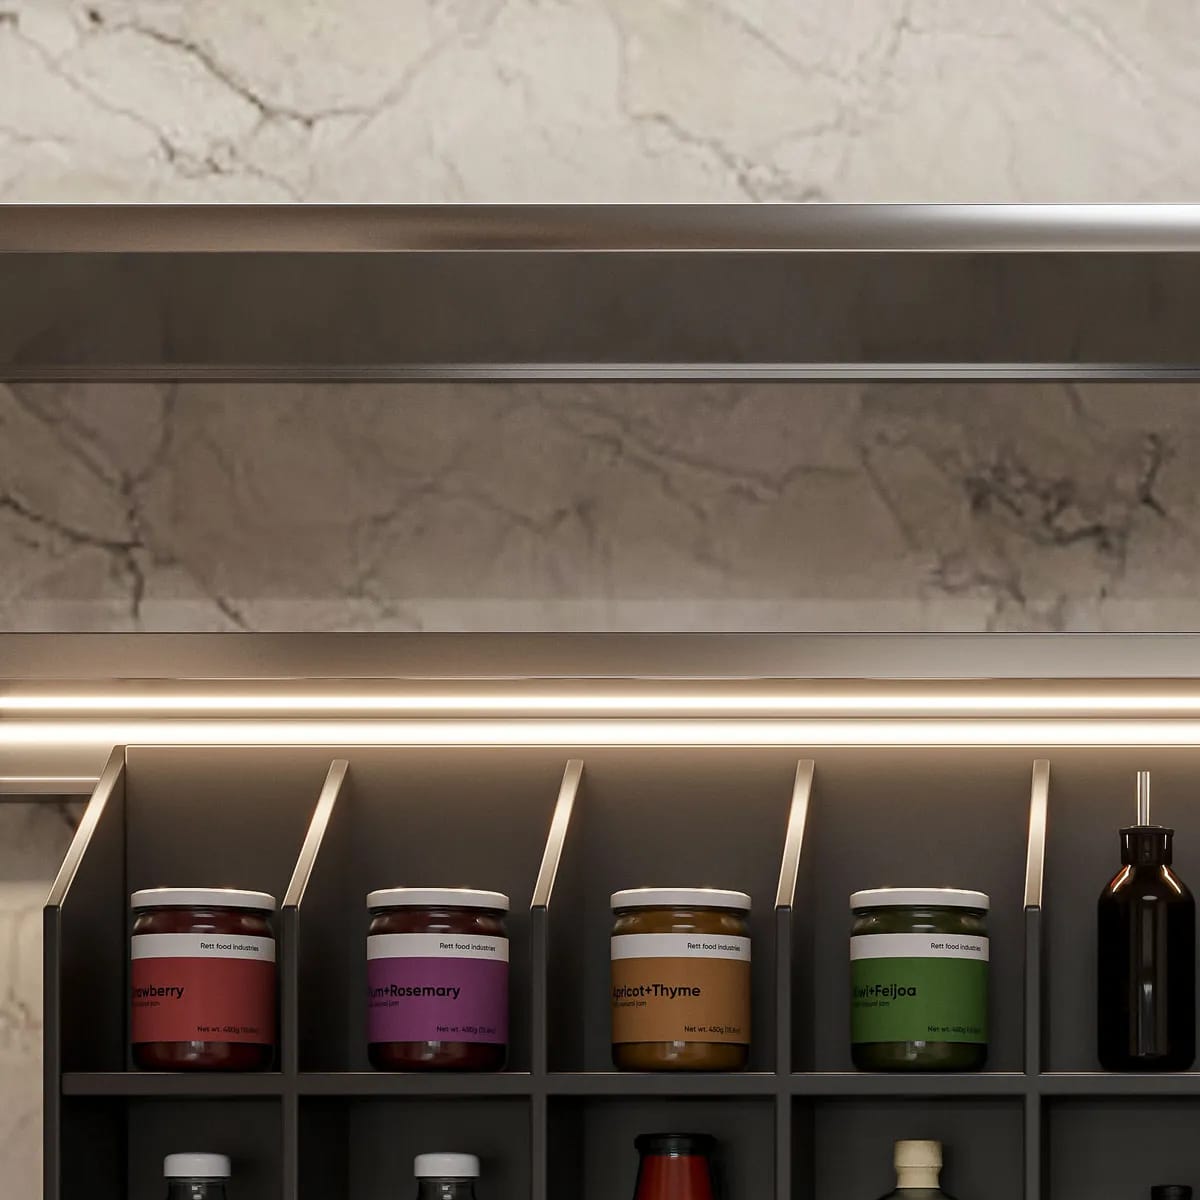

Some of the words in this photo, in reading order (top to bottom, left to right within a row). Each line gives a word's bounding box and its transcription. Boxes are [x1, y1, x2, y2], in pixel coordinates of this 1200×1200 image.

[200, 942, 215, 950] Rett
[232, 943, 259, 952] industries
[439, 942, 454, 950] Rett
[687, 942, 701, 950] Rett
[930, 942, 944, 950] Rett
